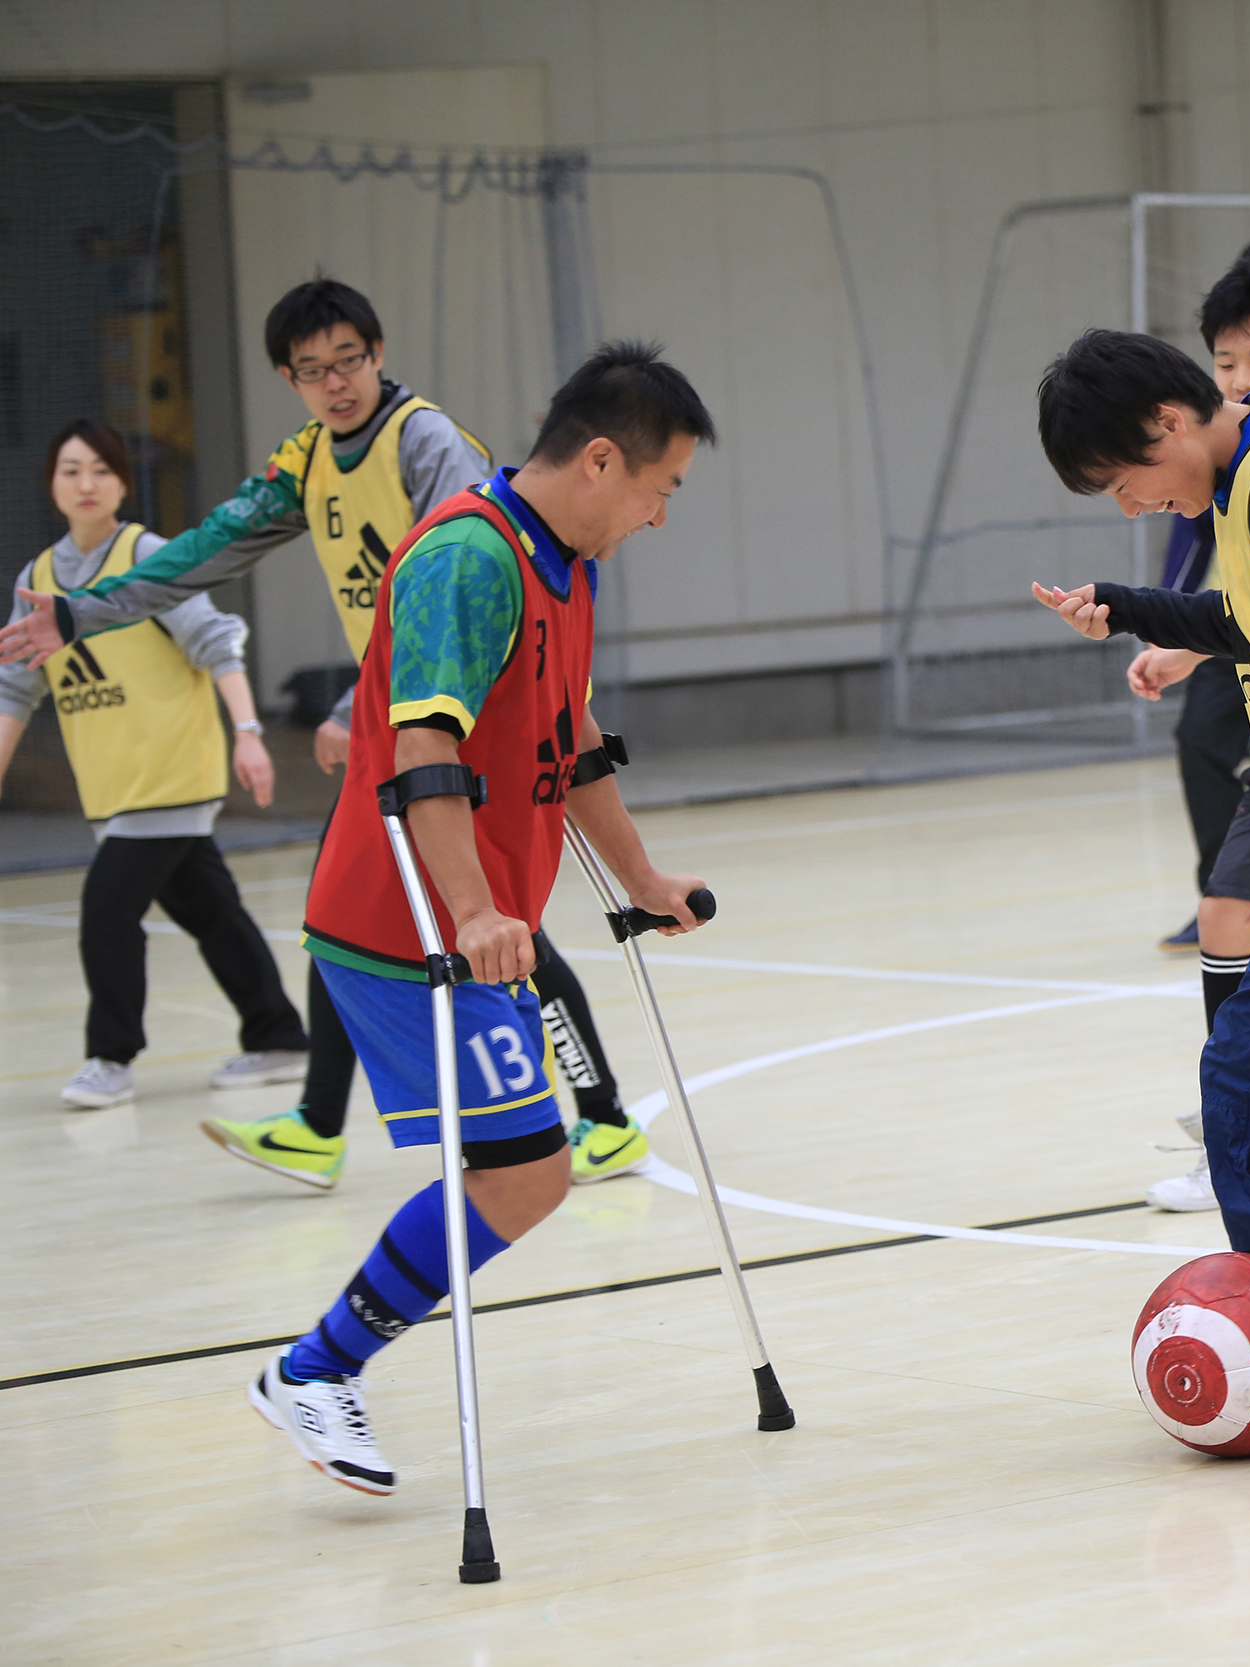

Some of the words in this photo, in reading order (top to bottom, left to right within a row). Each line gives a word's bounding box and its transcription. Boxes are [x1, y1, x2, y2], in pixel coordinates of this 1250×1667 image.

[326, 496, 344, 539] 6
[465, 1024, 535, 1099] 13
[540, 1000, 595, 1089] ATHLETA
